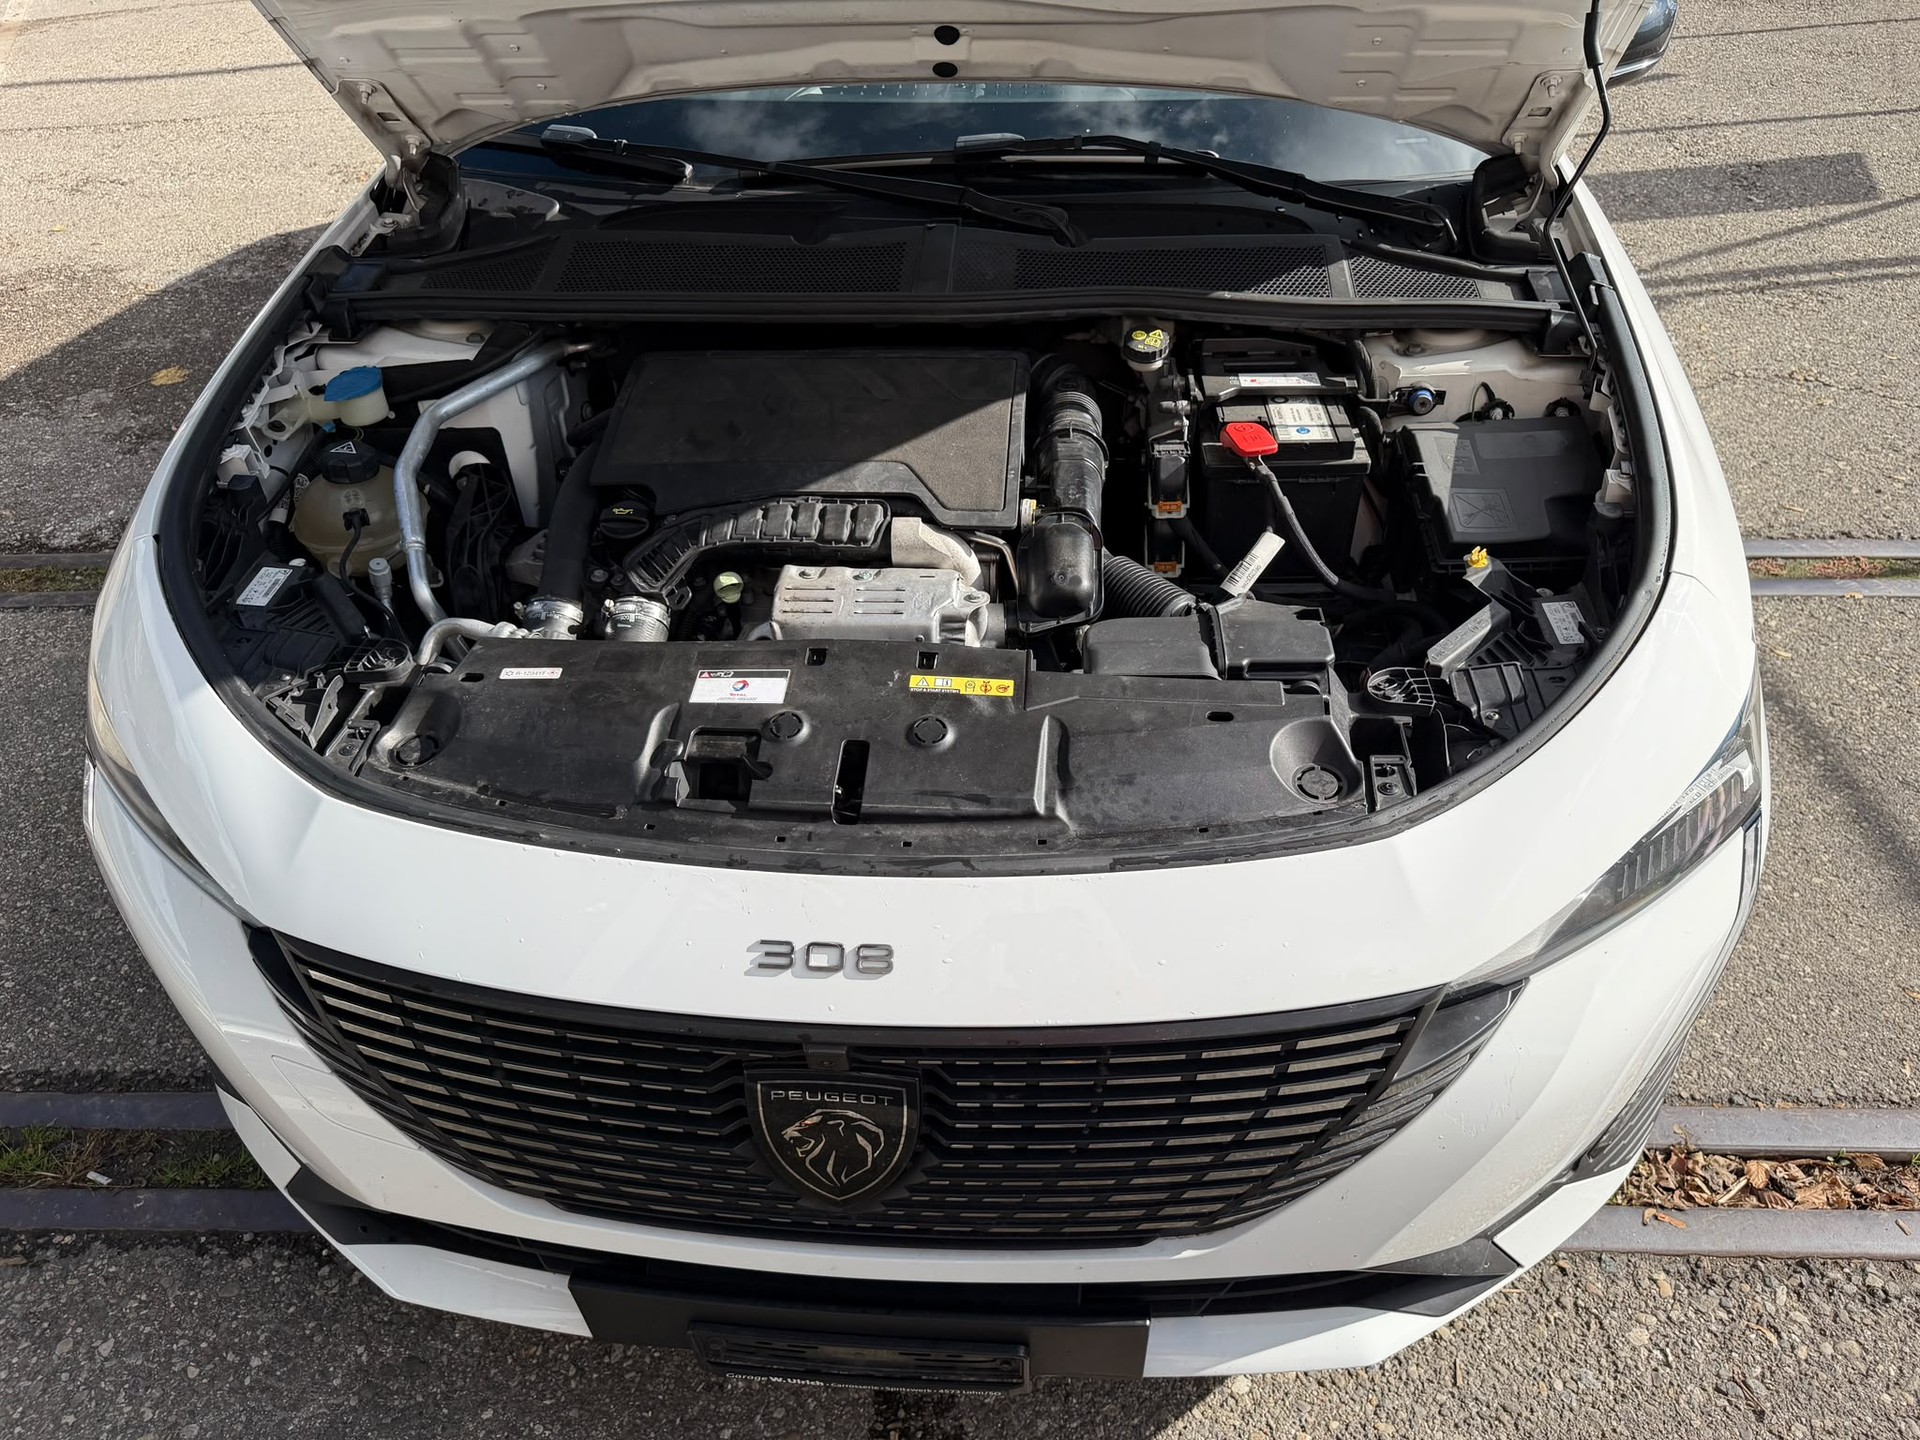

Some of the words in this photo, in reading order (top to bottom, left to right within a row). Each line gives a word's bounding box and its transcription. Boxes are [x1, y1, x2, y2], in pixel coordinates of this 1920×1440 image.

[758, 939, 894, 974] 308
[770, 1090, 894, 1106] PEUGEOT
[725, 1372, 768, 1382] Garage
[787, 1378, 824, 1386] Ulrich
